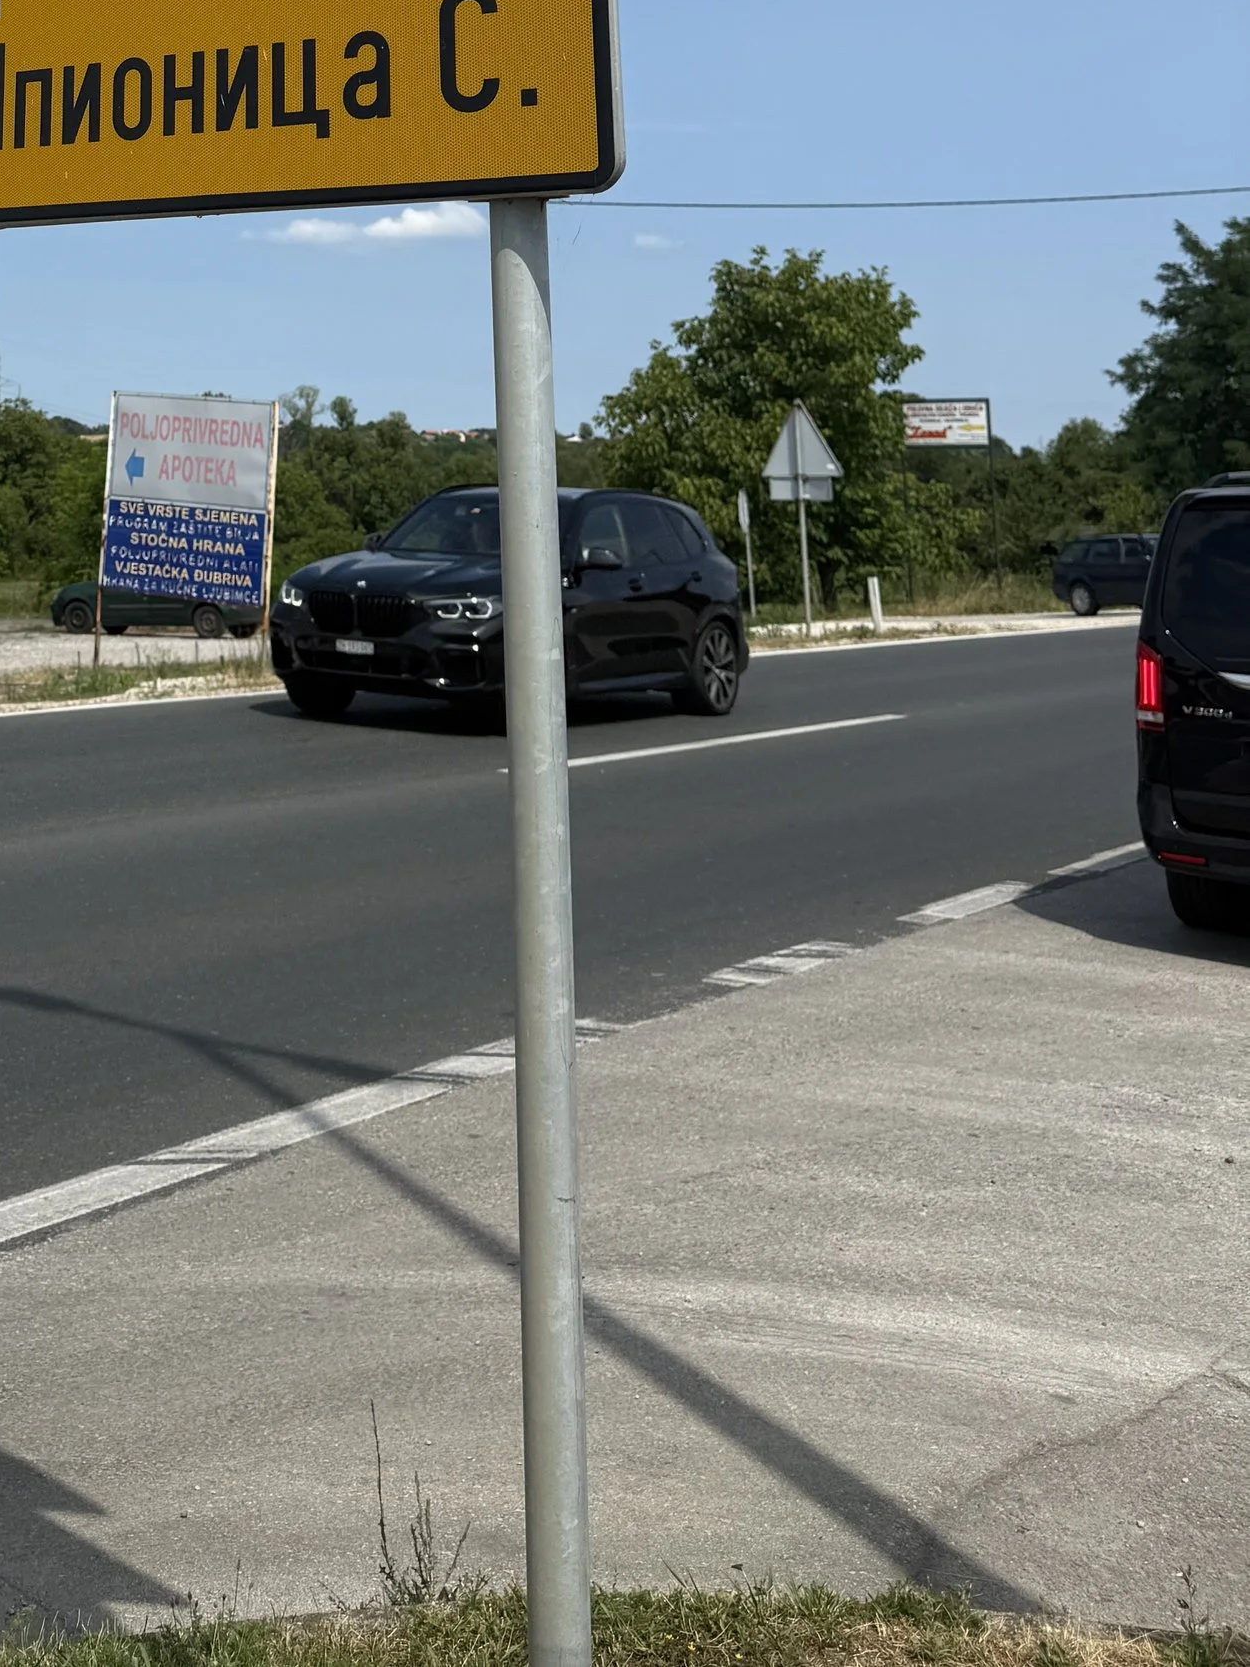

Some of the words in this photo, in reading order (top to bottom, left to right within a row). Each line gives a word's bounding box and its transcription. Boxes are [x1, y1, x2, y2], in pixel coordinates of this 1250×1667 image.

[119, 411, 265, 449] POLJOPRIVREDNA
[158, 453, 238, 487] APOTEKA
[119, 501, 145, 515] SVE
[147, 504, 190, 520] VRSTE
[194, 509, 259, 527] SJEMENA
[129, 531, 189, 551] STOČNA
[192, 539, 246, 556] HRANA
[114, 560, 190, 581] VJESTAČKA
[193, 570, 253, 588] ĐUBRIVA
